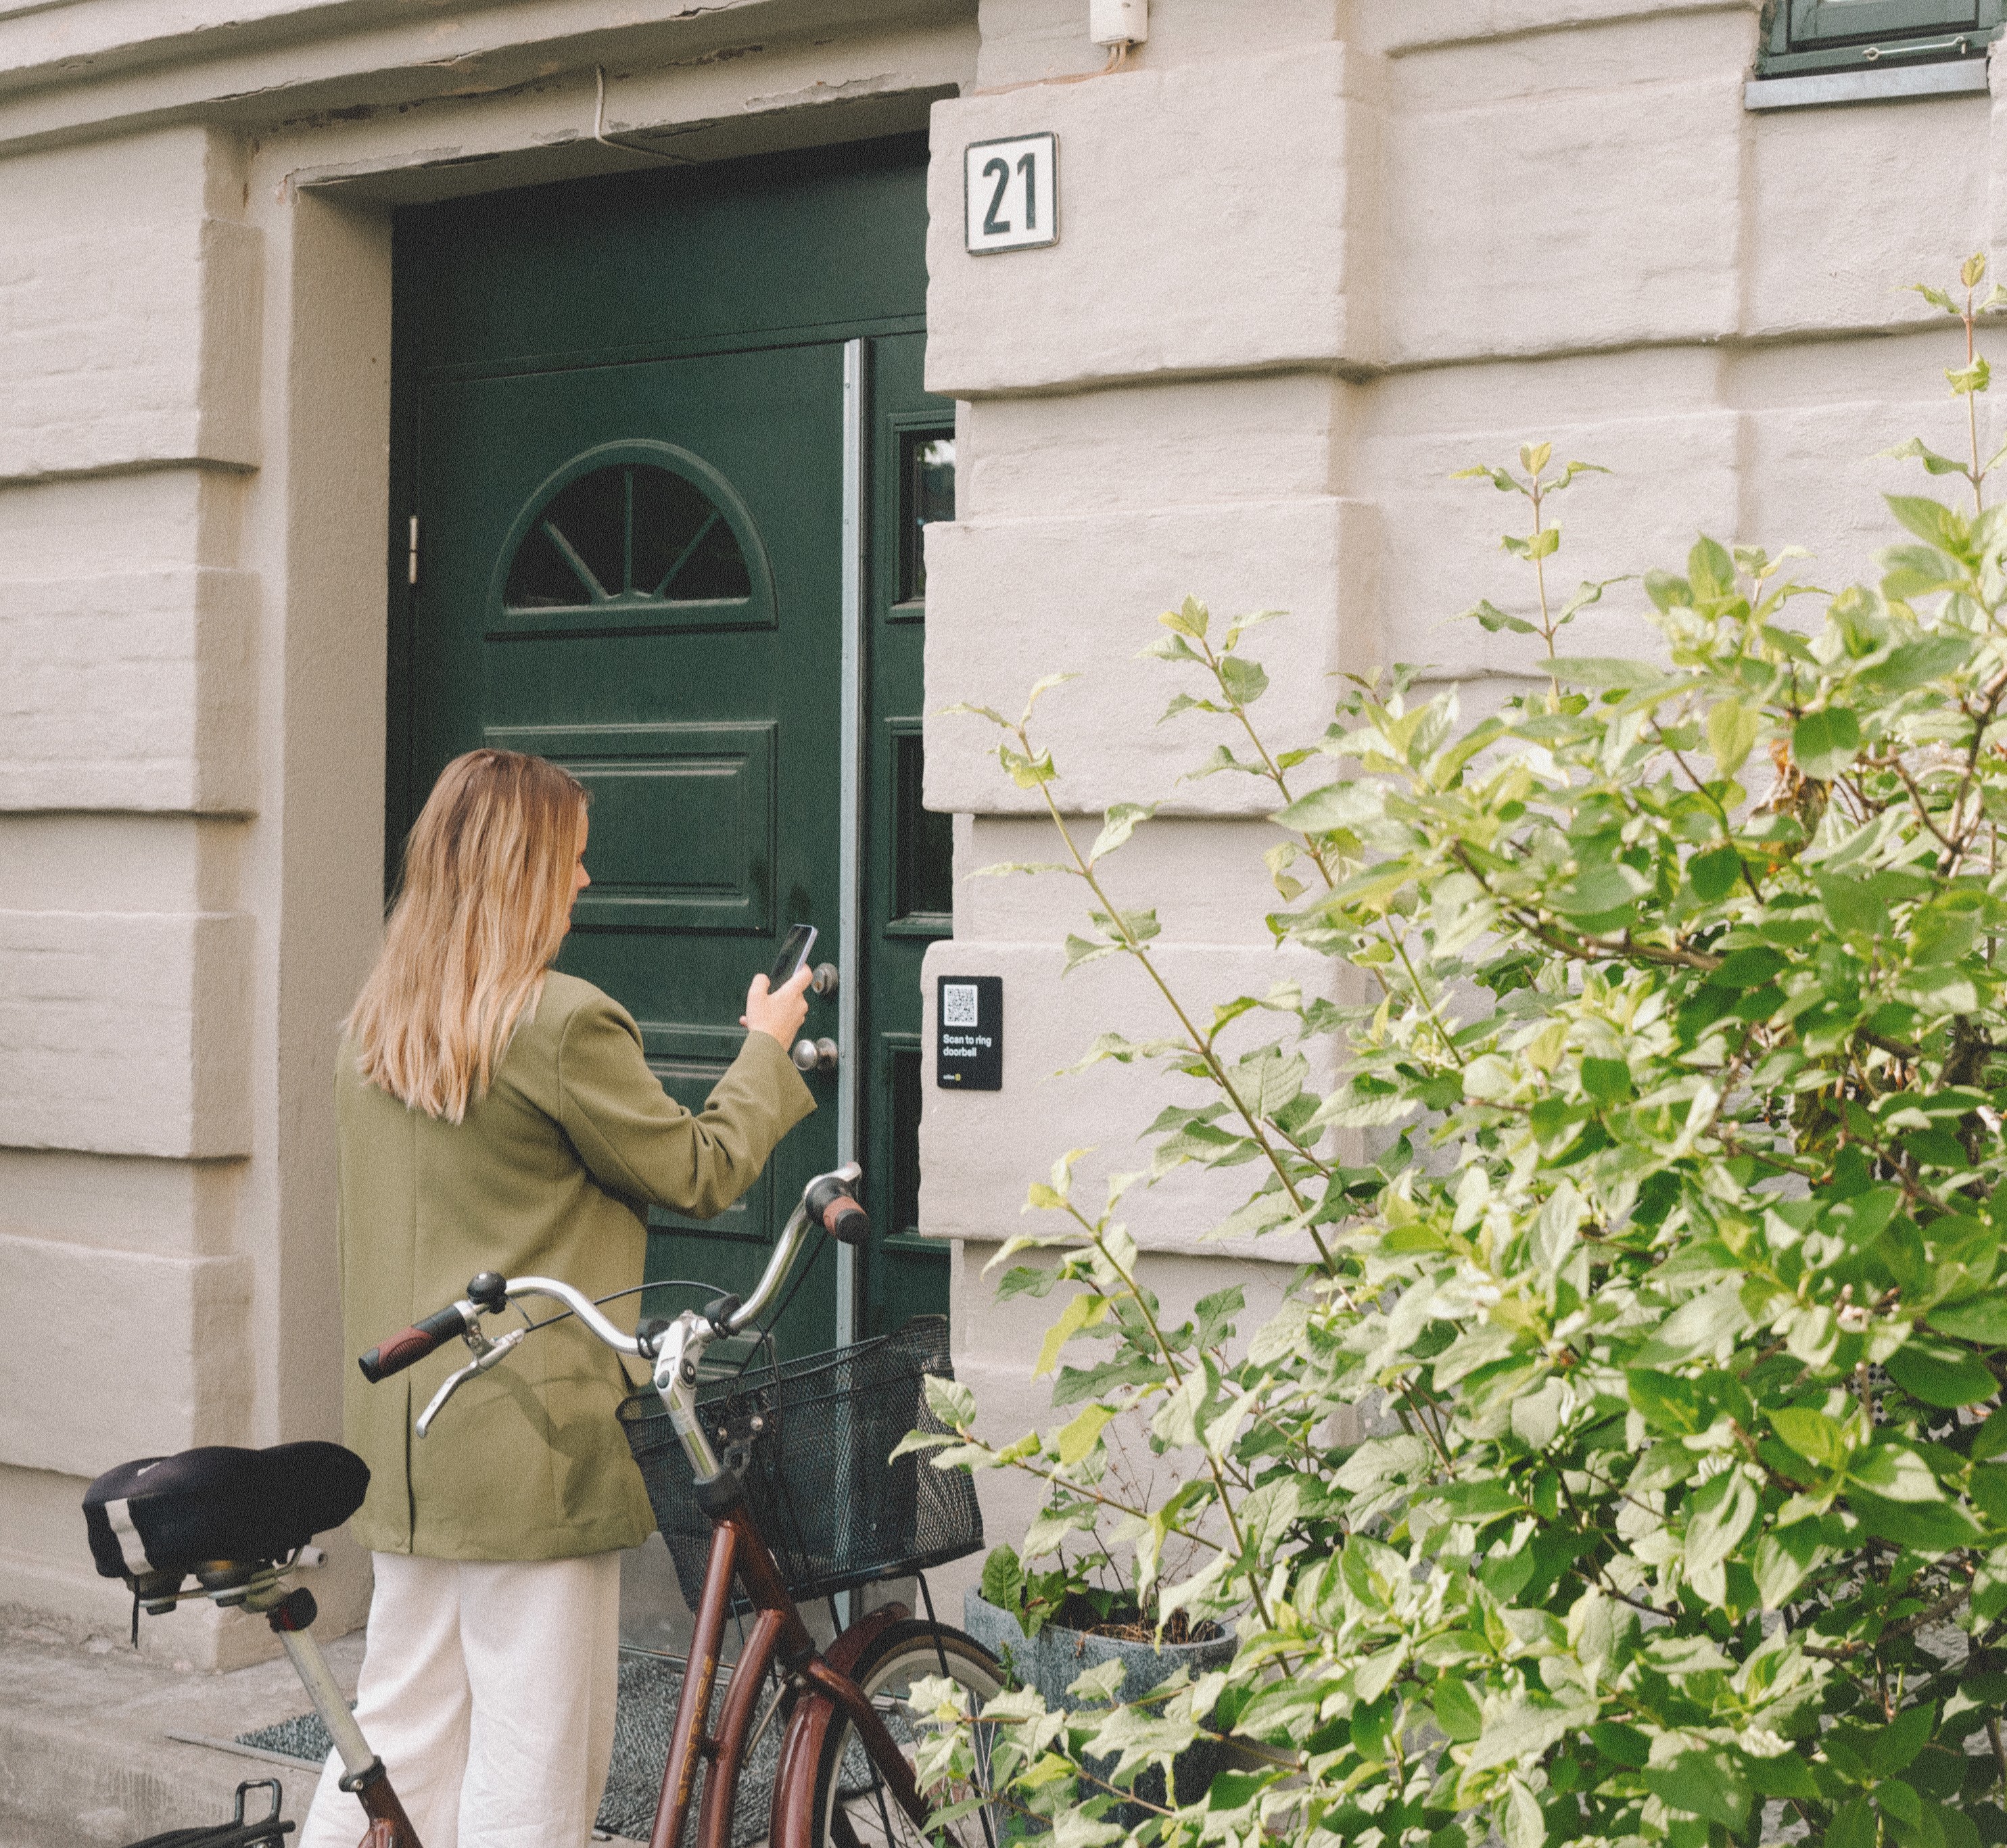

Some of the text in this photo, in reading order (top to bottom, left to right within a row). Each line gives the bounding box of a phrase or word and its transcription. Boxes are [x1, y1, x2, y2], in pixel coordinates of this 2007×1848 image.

[983, 152, 1036, 235] 21
[943, 1034, 992, 1047] Scan to ring
[943, 1046, 977, 1056] doorbell
